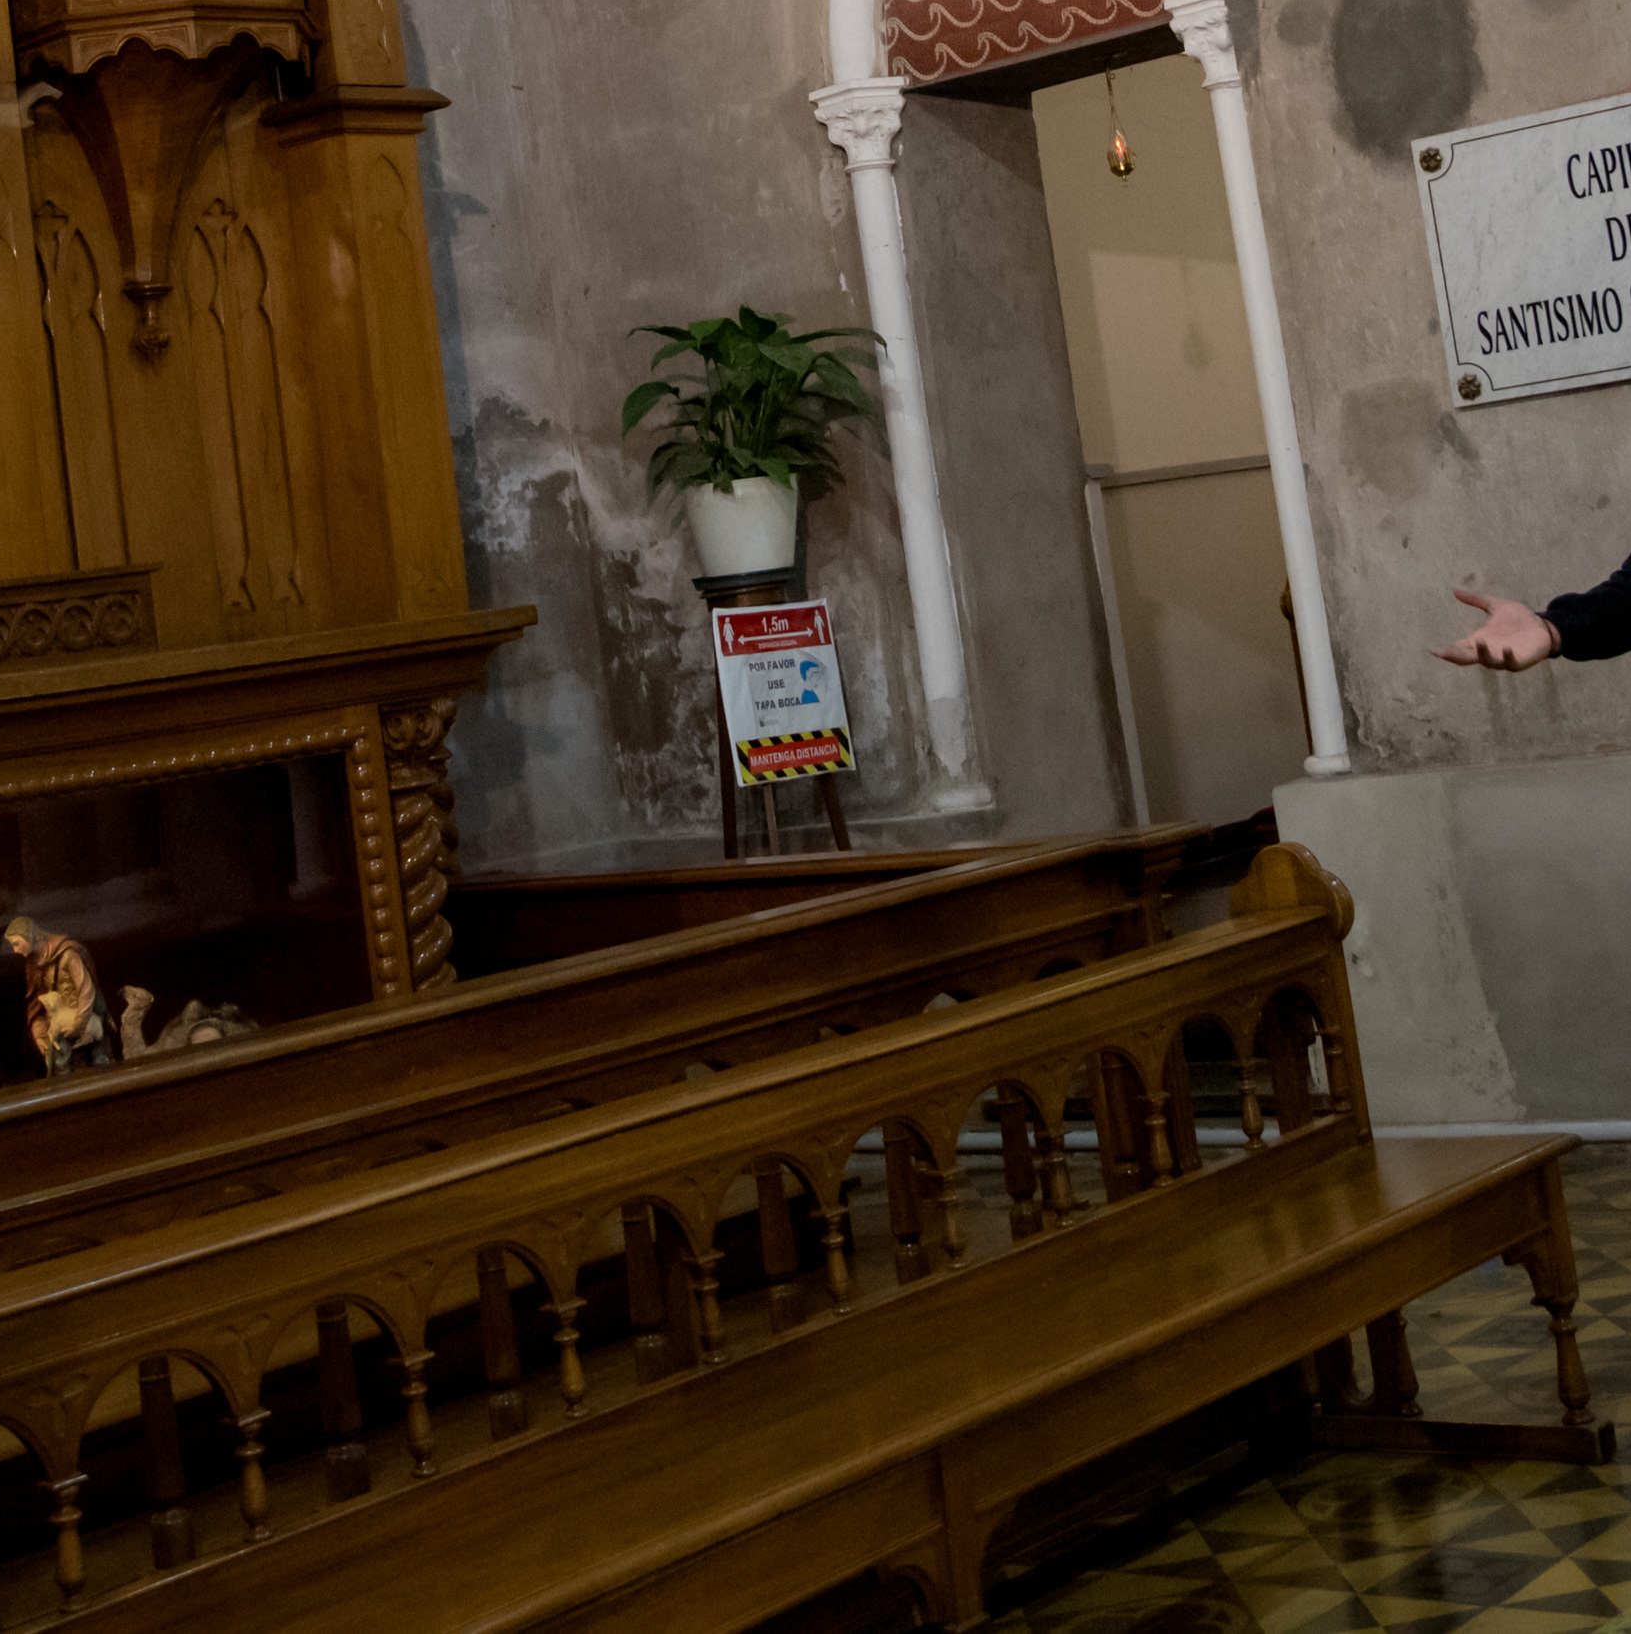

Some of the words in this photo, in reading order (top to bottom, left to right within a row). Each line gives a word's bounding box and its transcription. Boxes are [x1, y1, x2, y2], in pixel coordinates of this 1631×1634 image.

[1477, 287, 1623, 355] SANTISIMO
[761, 616, 789, 635] 1,5m
[748, 662, 766, 672] POR
[767, 658, 796, 670] FAVOR
[767, 679, 786, 690] USE
[755, 698, 777, 711] TAPA
[778, 697, 801, 708] BOCA
[749, 750, 796, 766] MANTENGA
[796, 743, 838, 760] DISTANCIA
